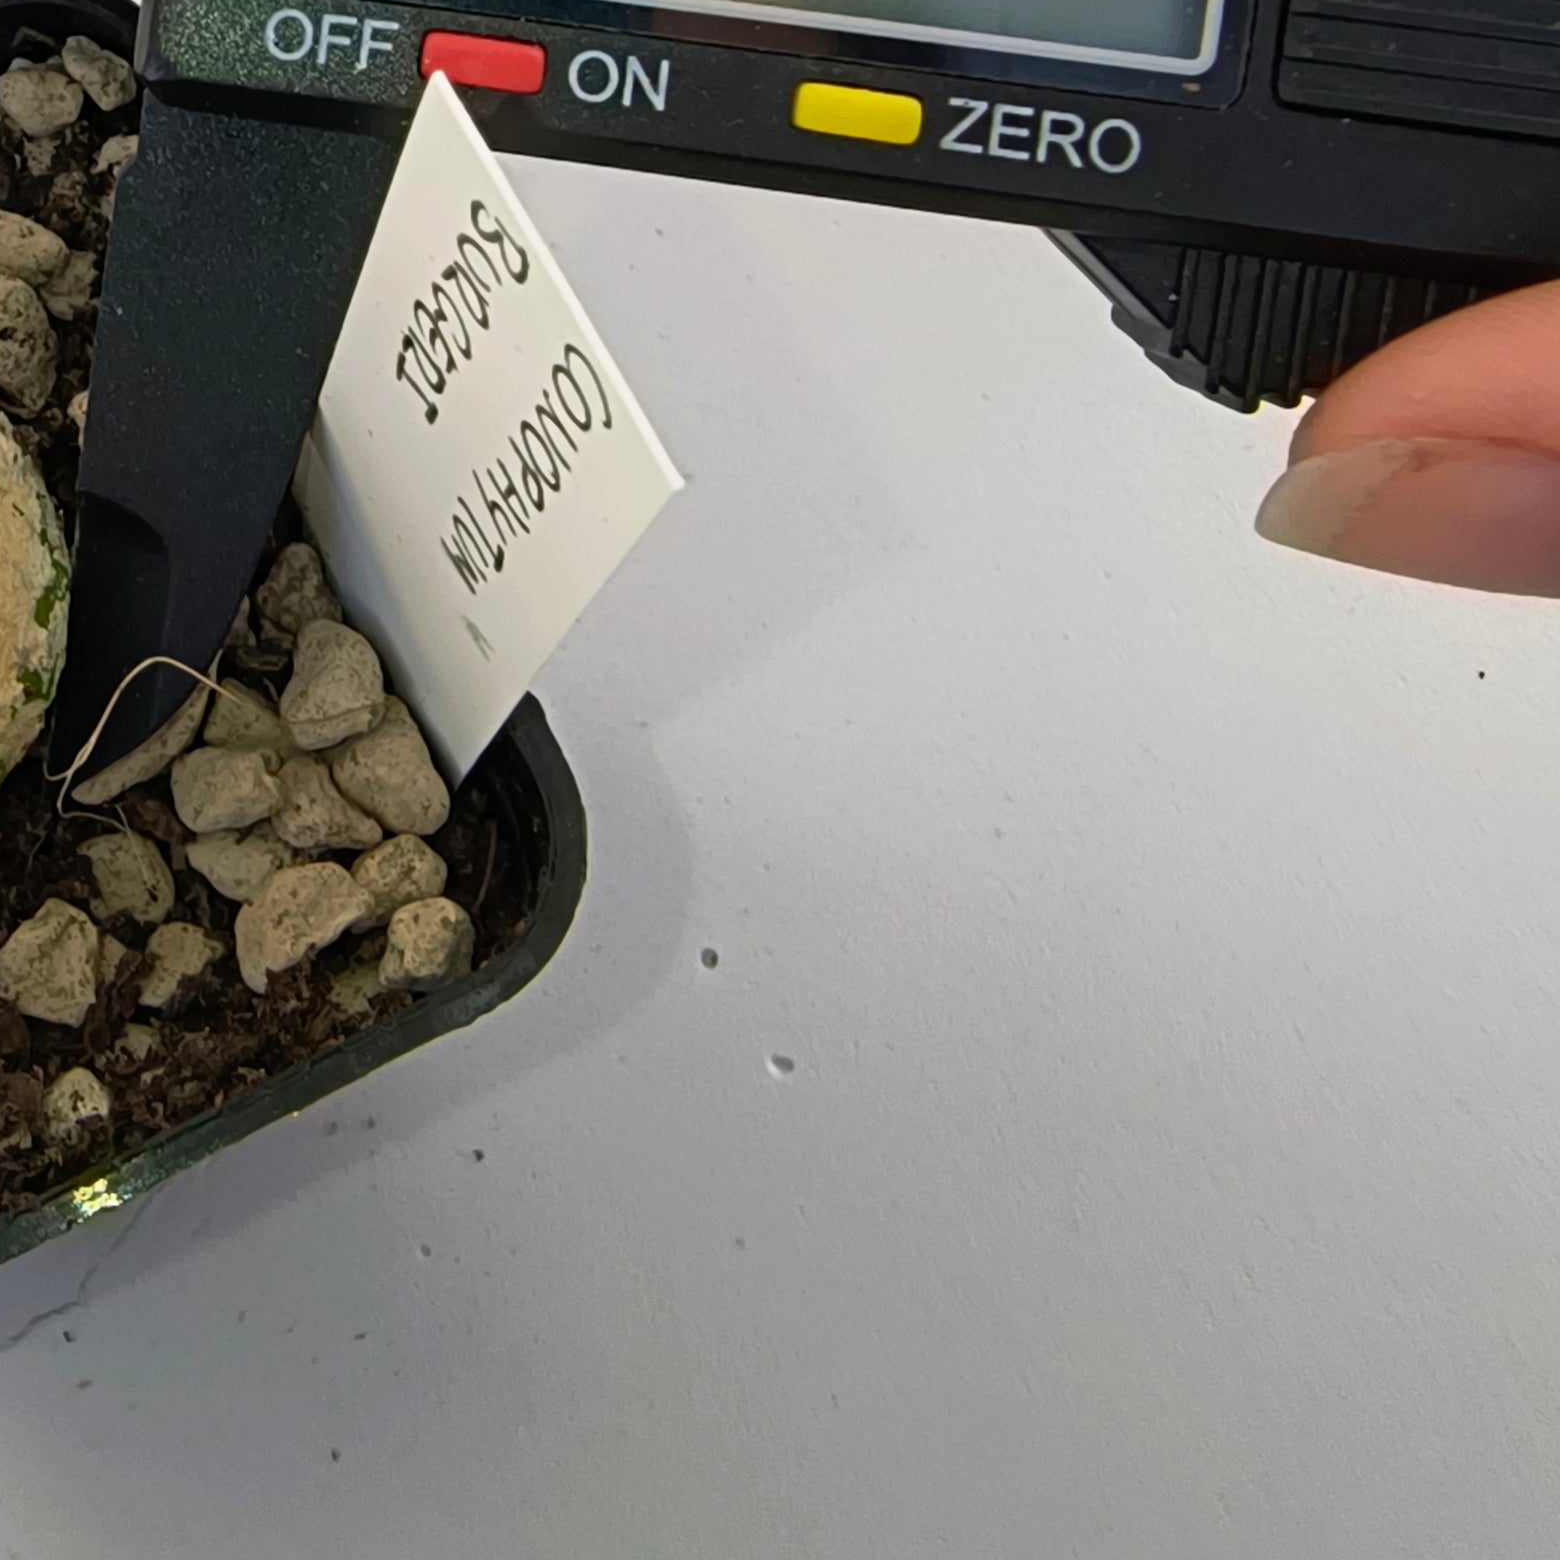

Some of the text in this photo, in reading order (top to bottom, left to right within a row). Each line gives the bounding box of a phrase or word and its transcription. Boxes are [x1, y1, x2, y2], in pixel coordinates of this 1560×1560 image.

[264, 6, 1142, 177] OFF ON ZERO
